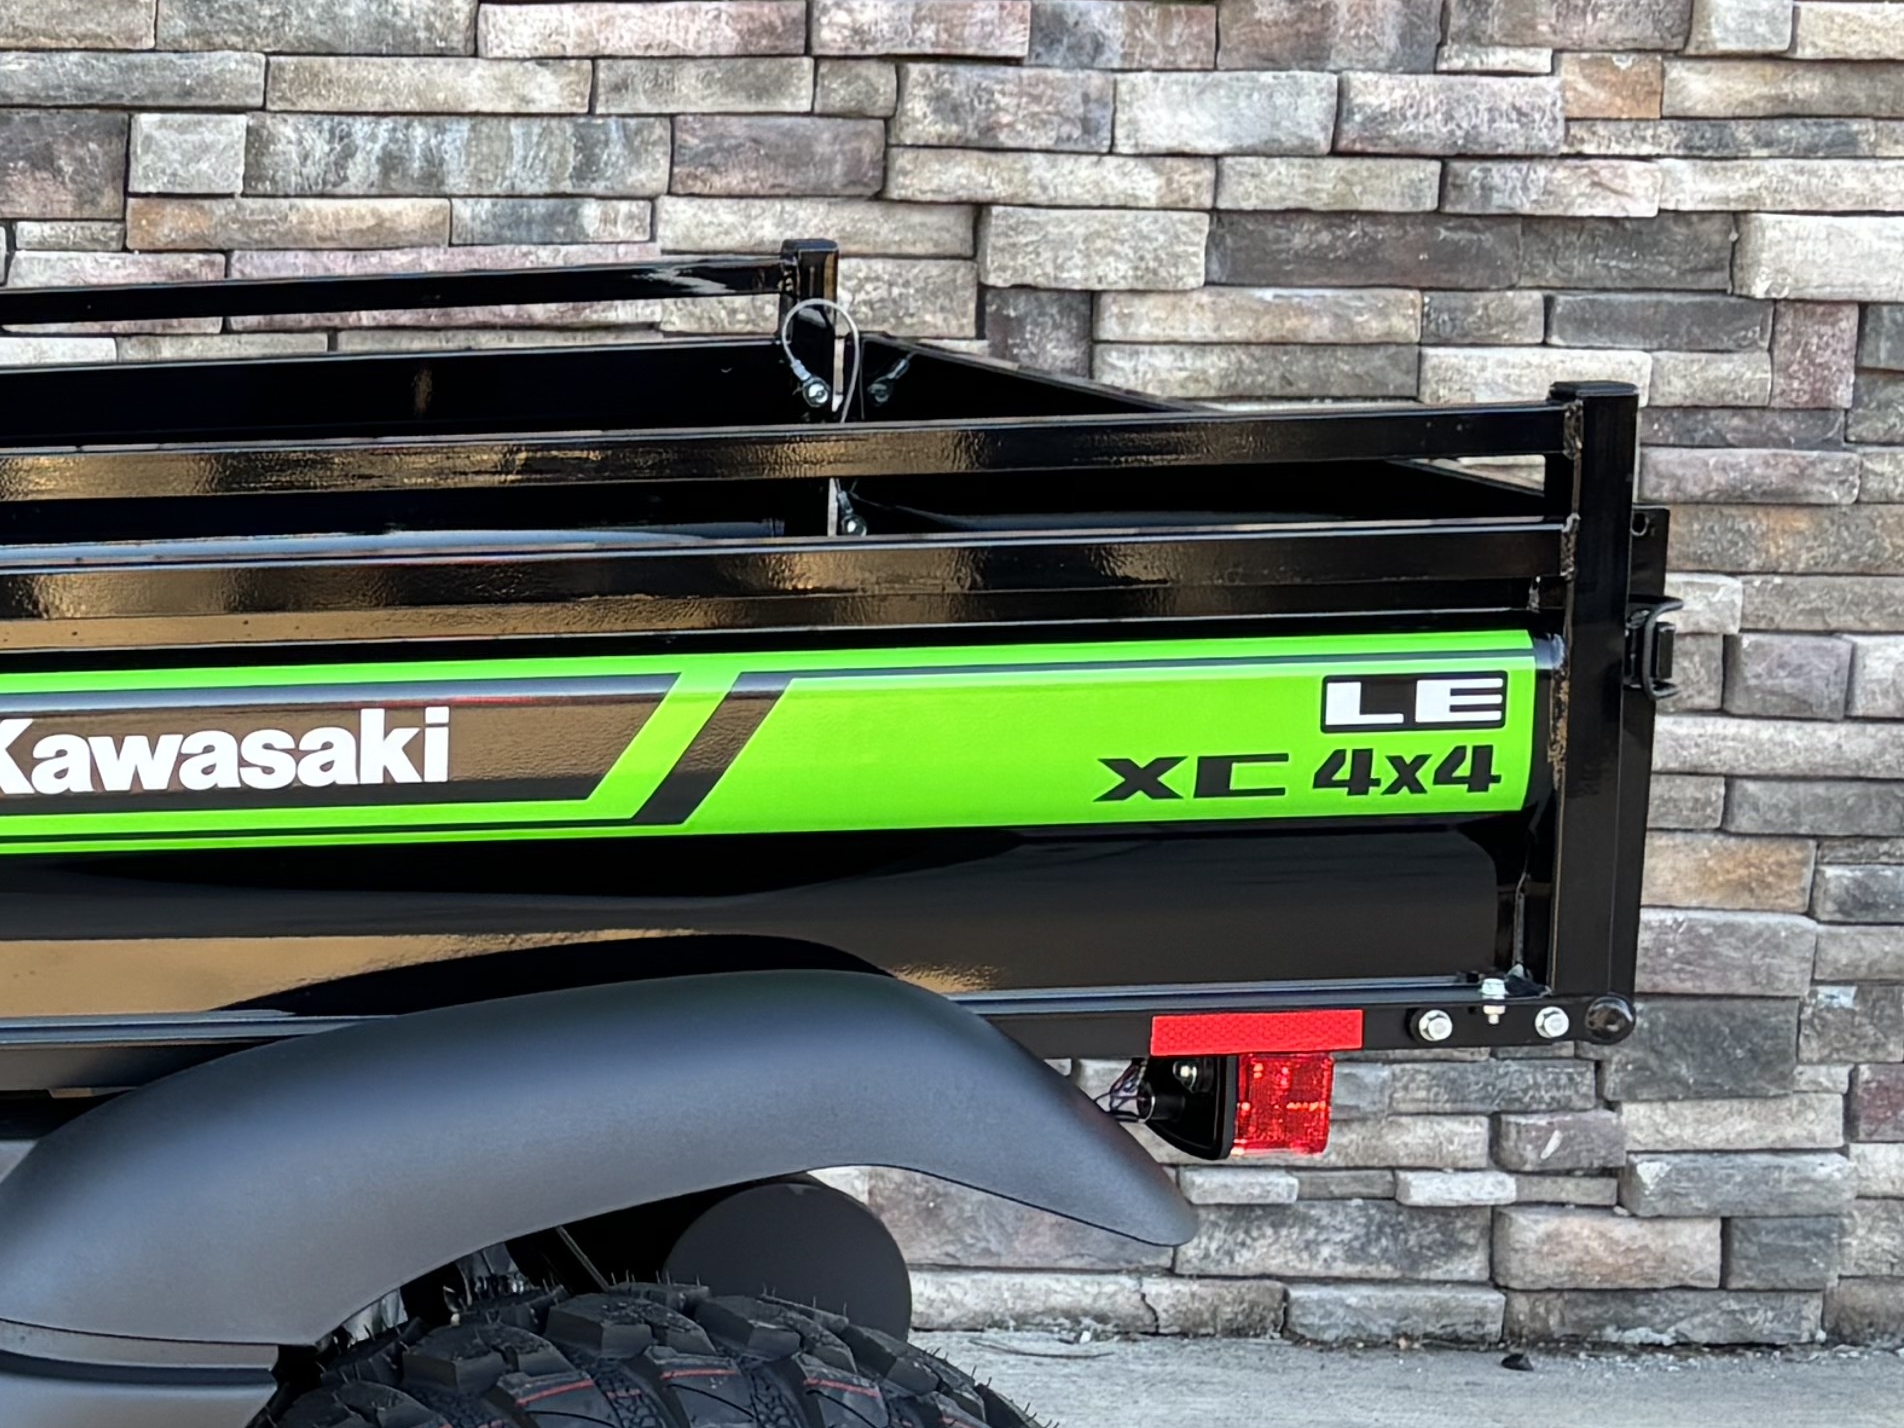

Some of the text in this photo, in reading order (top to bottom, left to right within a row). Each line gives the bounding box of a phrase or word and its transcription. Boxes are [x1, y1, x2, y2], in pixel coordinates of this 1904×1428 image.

[1325, 677, 1505, 726] LE
[1093, 744, 1502, 802] XC 4x4
